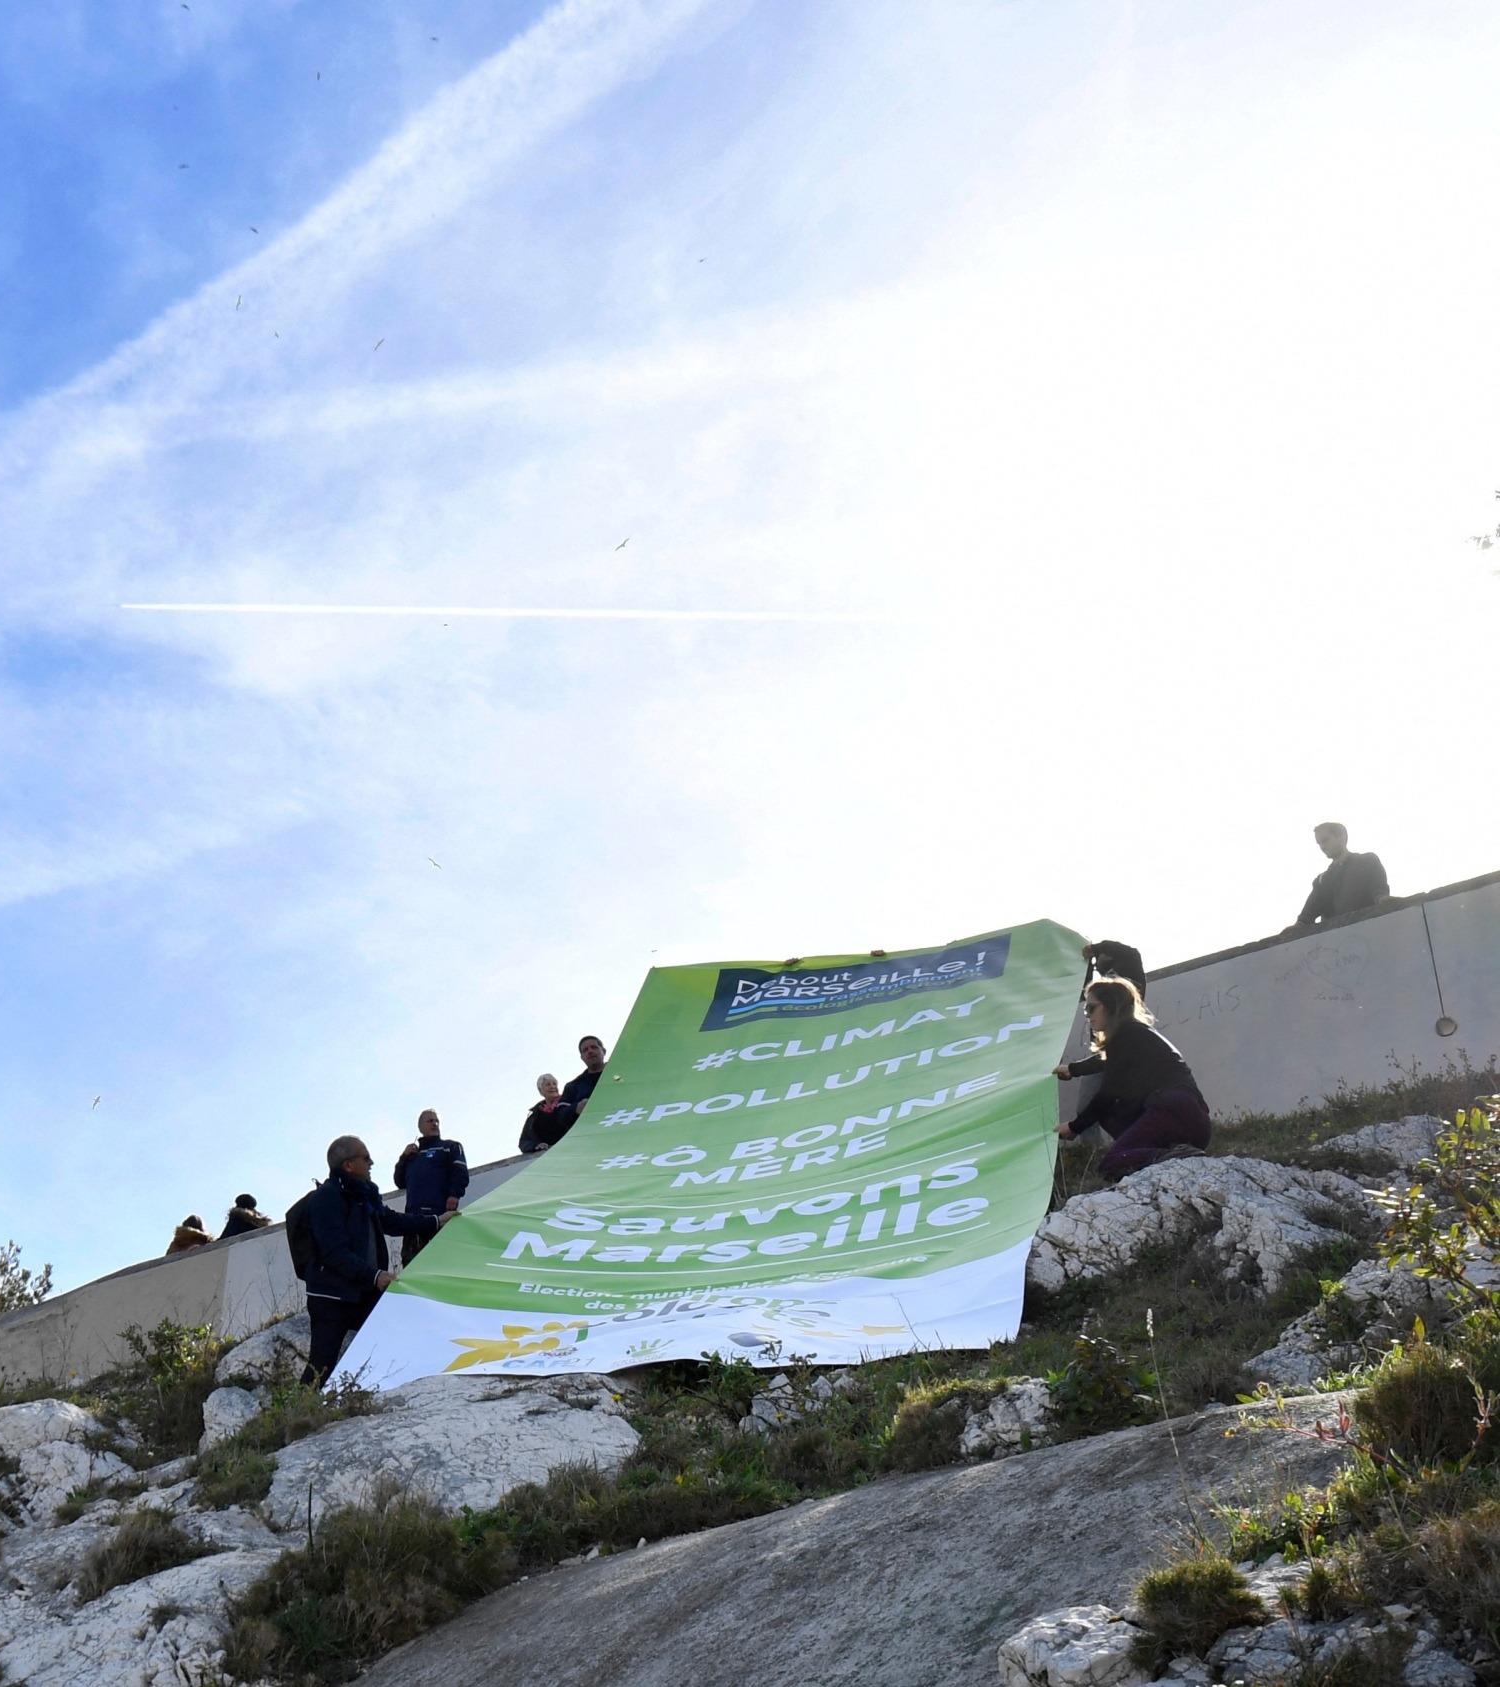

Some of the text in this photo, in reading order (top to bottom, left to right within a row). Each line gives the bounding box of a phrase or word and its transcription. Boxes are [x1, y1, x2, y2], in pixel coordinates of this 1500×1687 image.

[736, 971, 852, 995] Debout
[975, 951, 987, 967] !
[691, 994, 987, 1072] #CLIMAT
[597, 1013, 1046, 1128] #POLLUTION
[595, 1070, 1003, 1171] #Ô BONNE
[669, 1127, 892, 1189] MÈRE
[499, 1197, 990, 1264] Marseille
[543, 1157, 980, 1236] Sauvons
